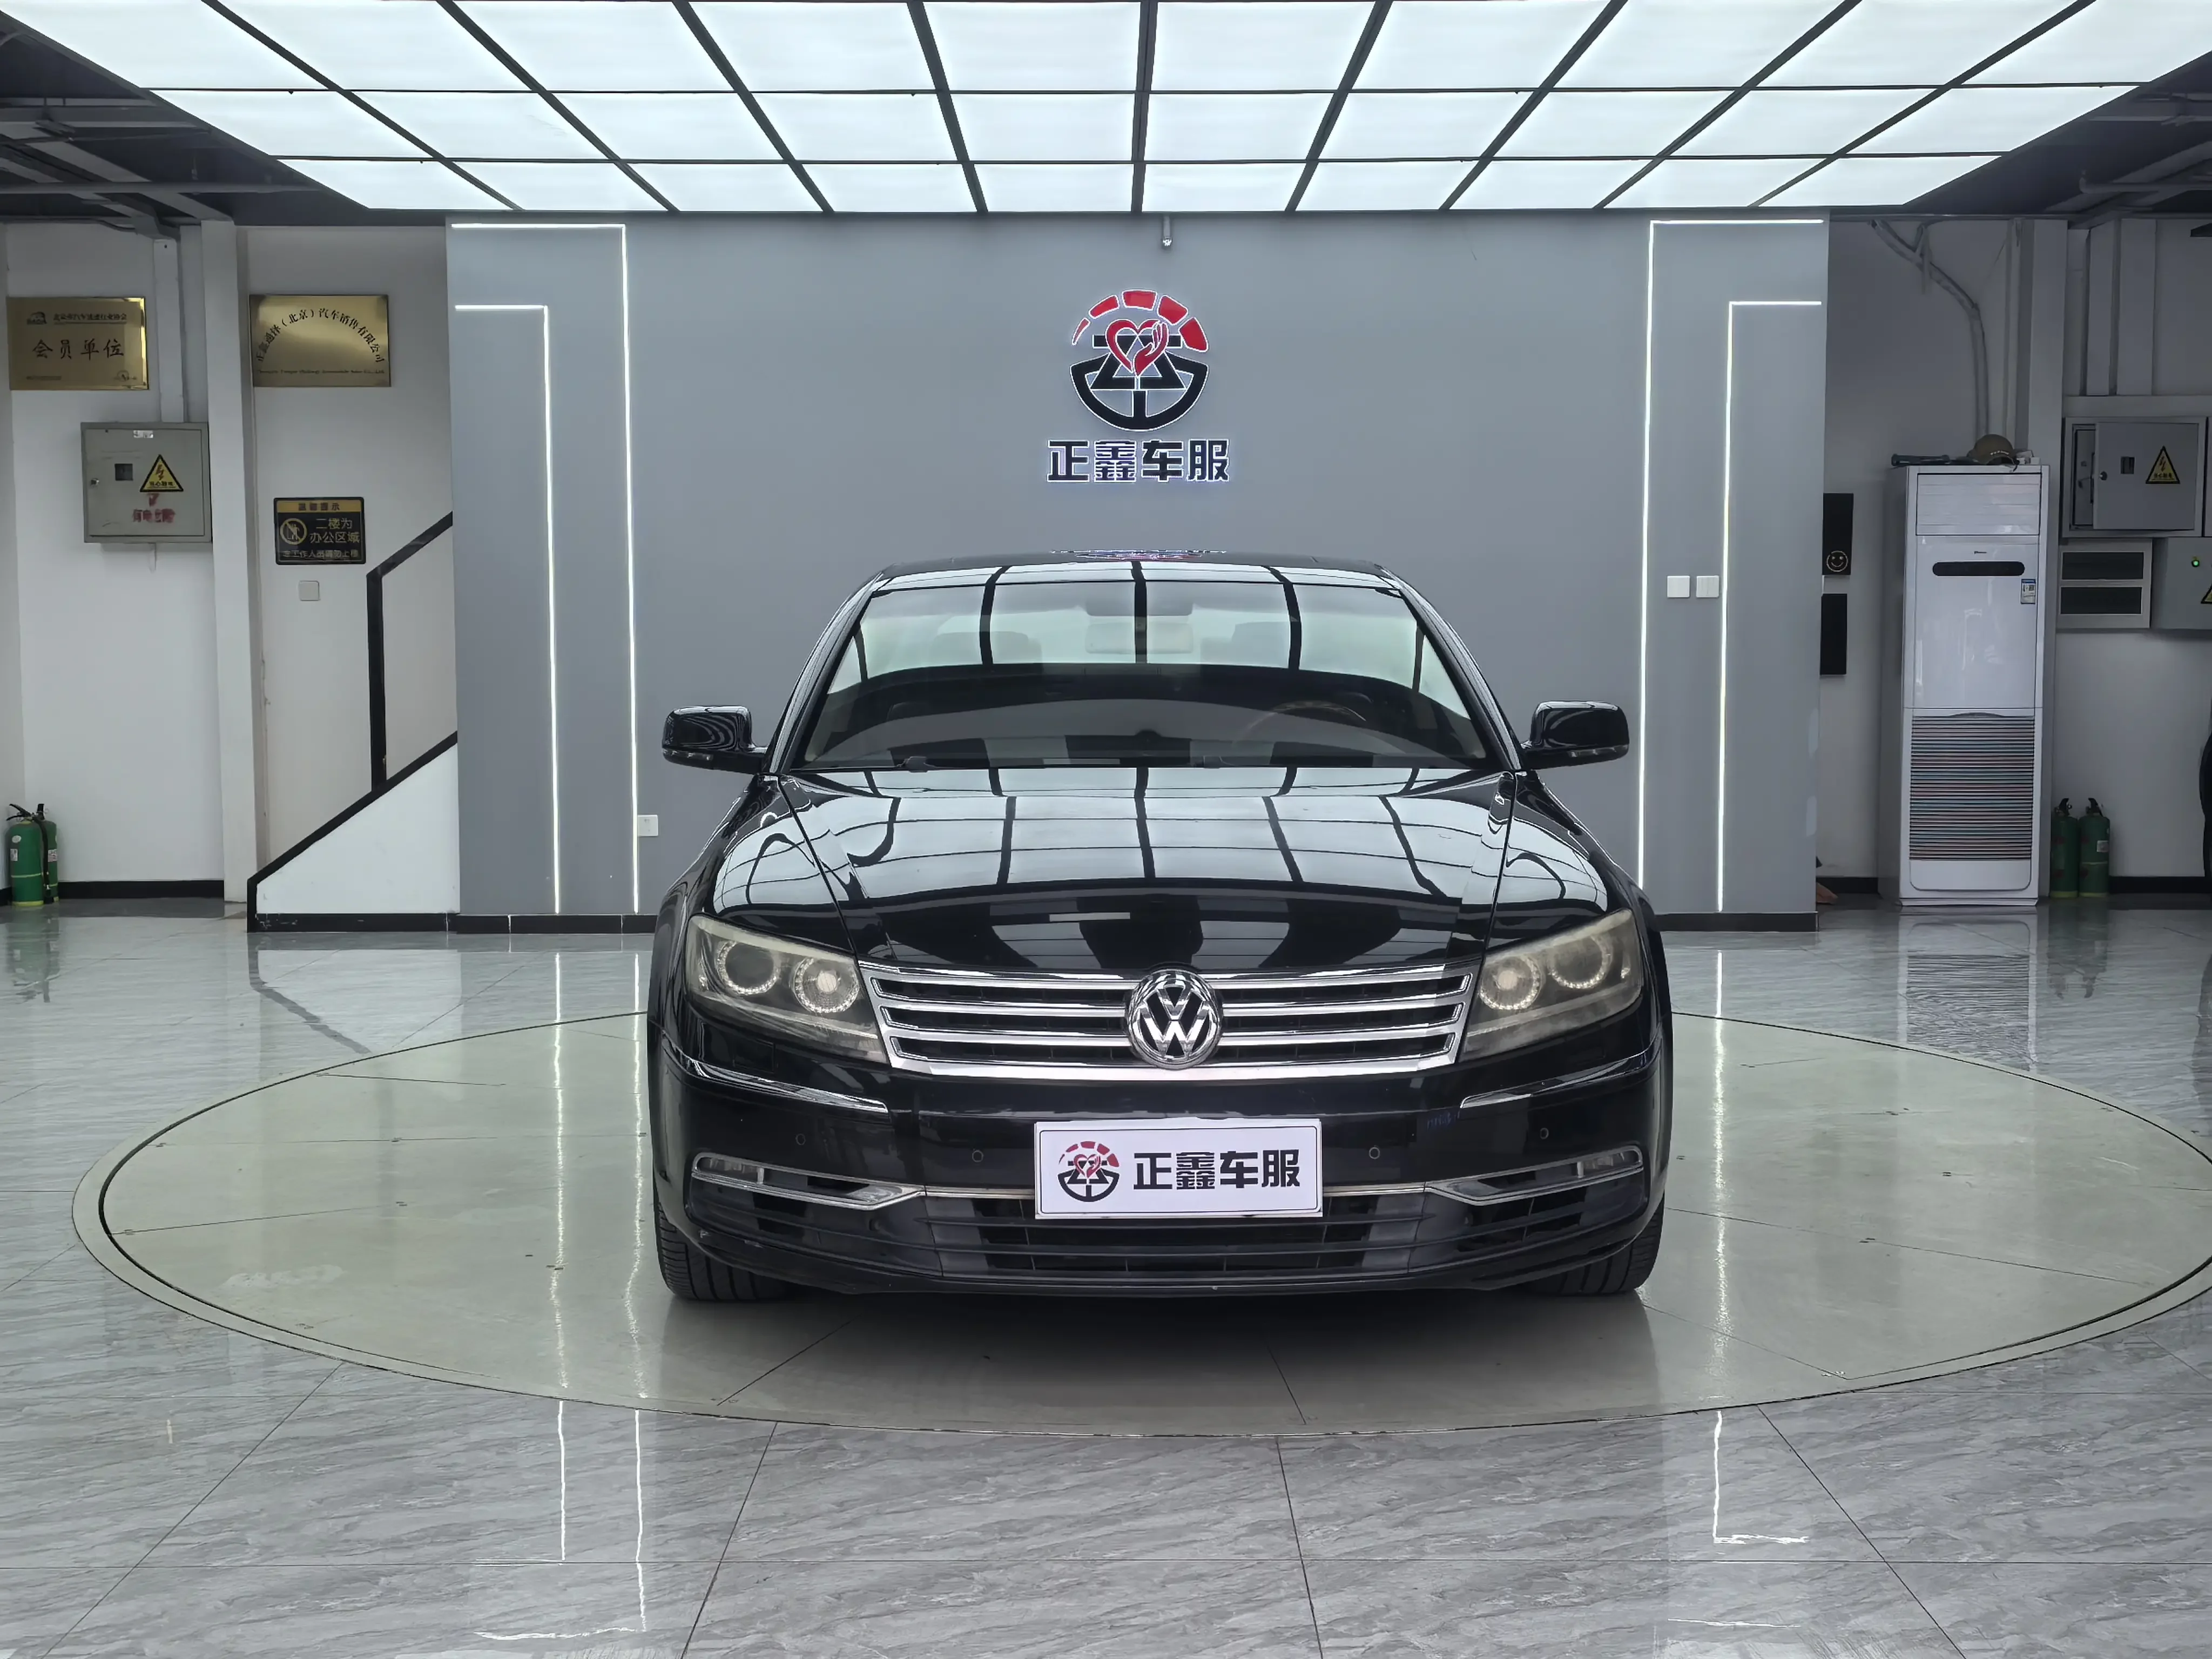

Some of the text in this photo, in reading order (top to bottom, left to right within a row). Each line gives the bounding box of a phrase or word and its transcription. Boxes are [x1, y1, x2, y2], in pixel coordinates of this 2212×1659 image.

[32, 339, 124, 361] 会员单位
[1046, 439, 1230, 482] 正鑫车服
[316, 518, 353, 529] 二楼为
[309, 531, 360, 543] 办公区域
[1134, 1149, 1300, 1190] 正鑫车服
